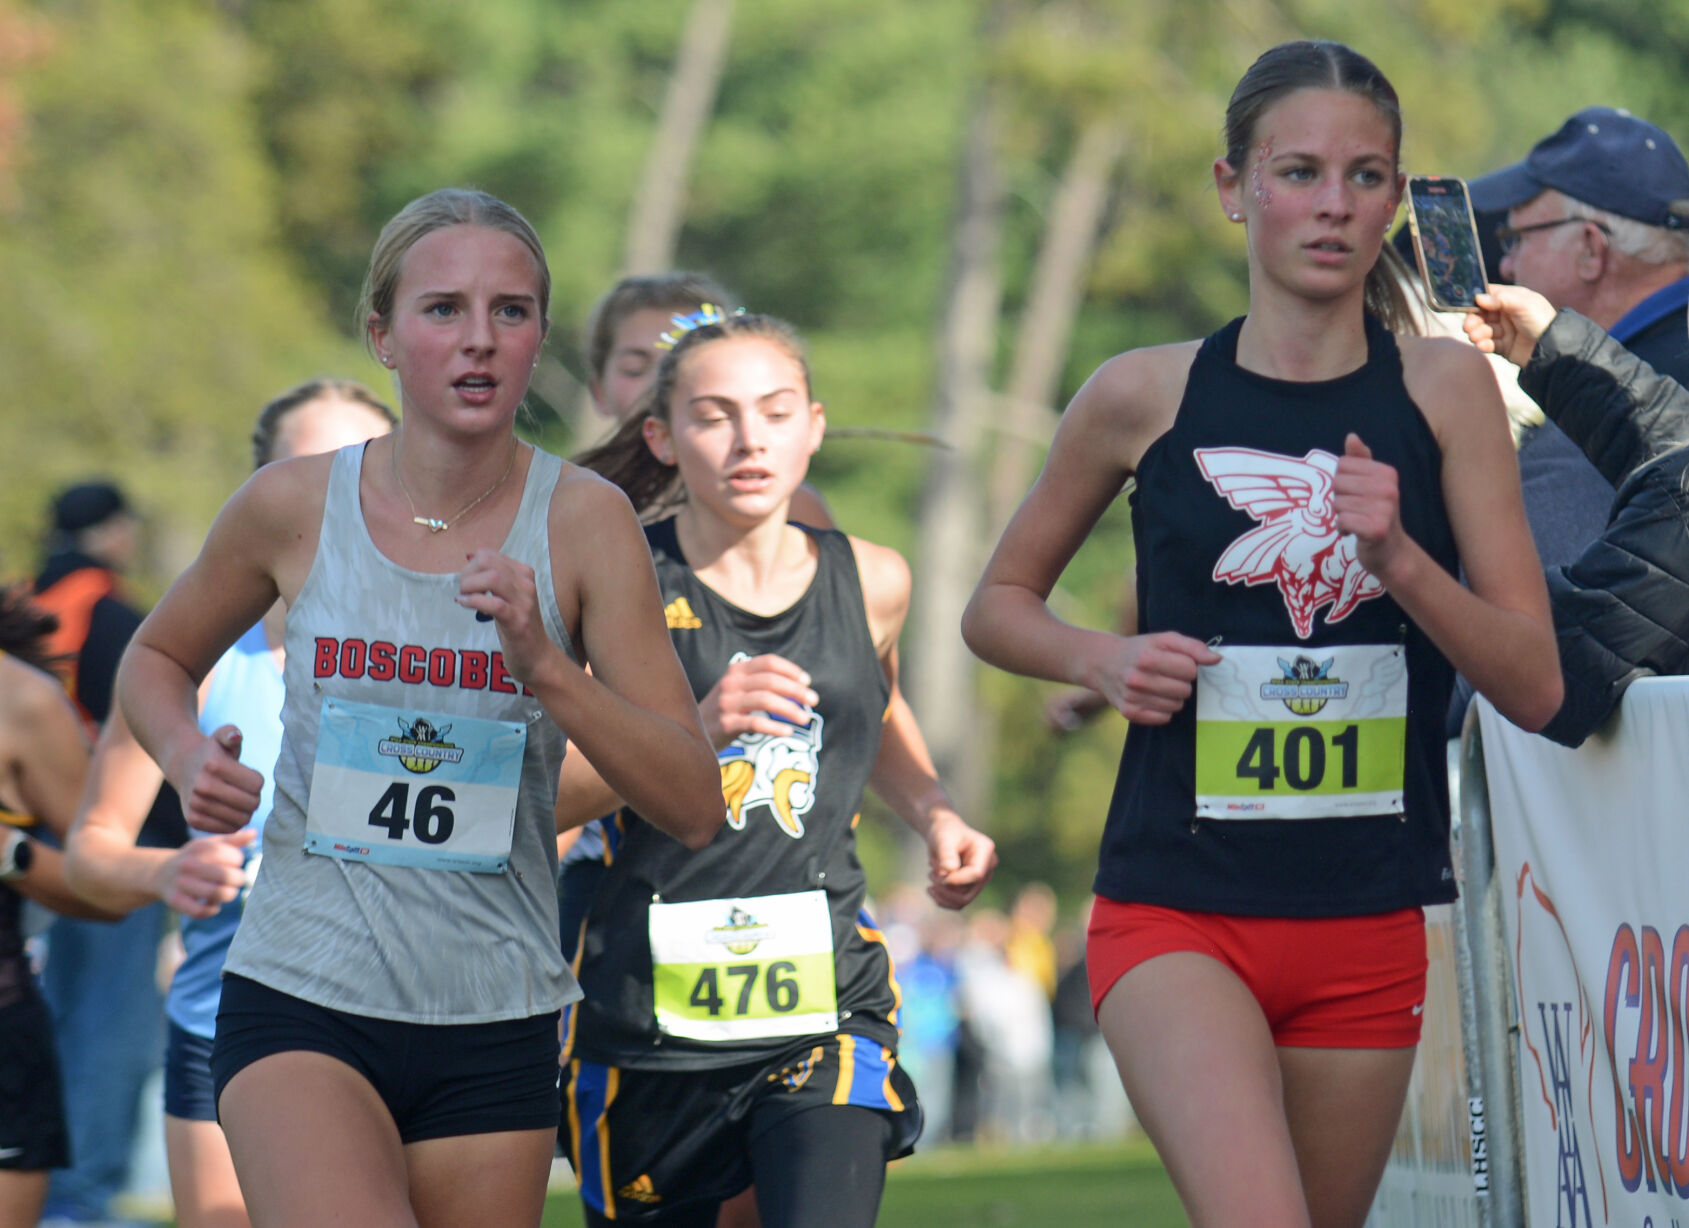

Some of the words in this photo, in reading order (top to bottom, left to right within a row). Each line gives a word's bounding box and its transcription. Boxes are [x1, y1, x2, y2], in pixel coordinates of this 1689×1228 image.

[314, 637, 535, 697] BOSCOBE
[1262, 685, 1297, 697] CROSS
[1299, 683, 1346, 697] COUNTRY
[380, 742, 414, 755] CROSS
[415, 746, 462, 761] COUNTRY
[1236, 725, 1358, 790] 401
[368, 782, 456, 845] 46
[689, 961, 801, 1017] 476
